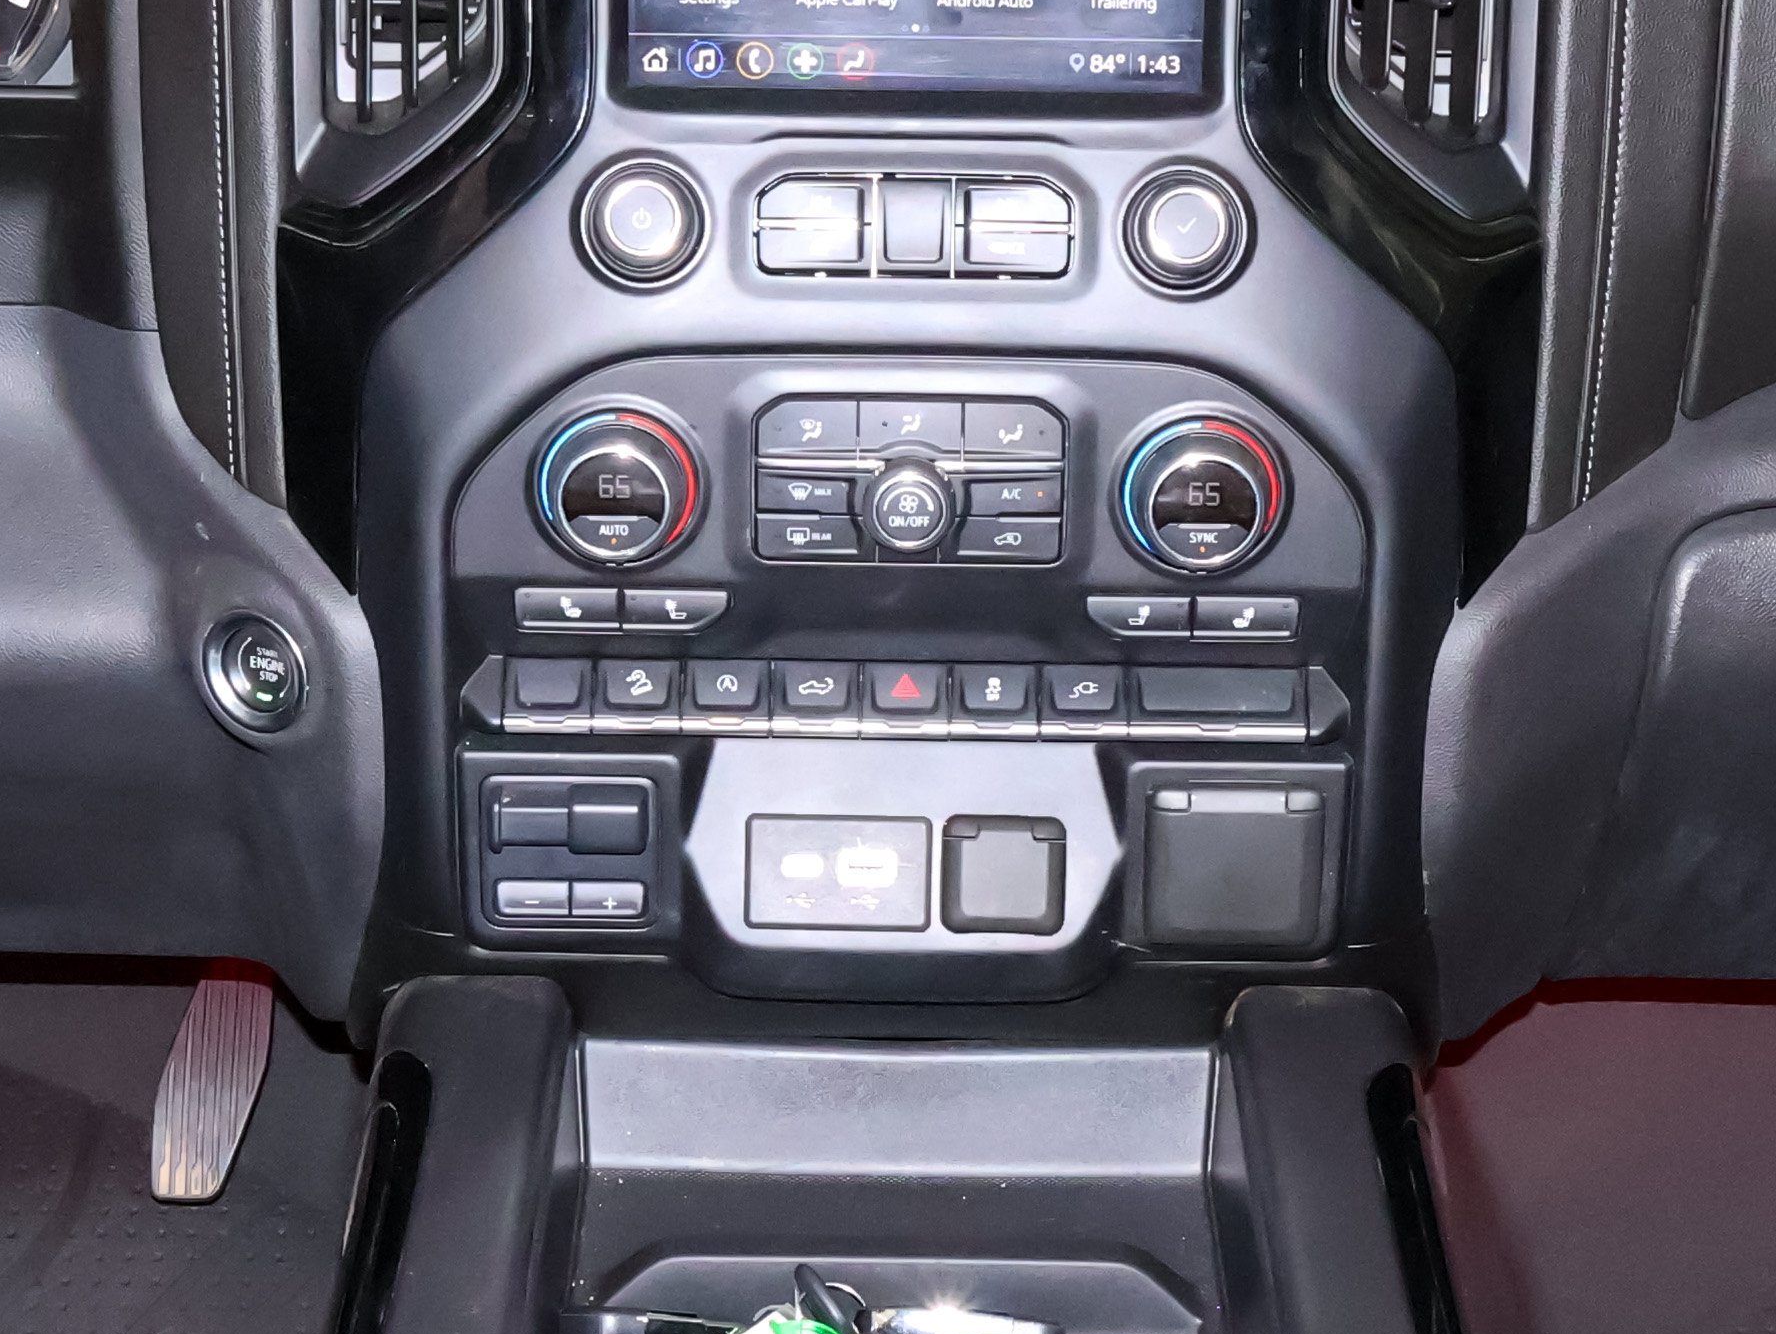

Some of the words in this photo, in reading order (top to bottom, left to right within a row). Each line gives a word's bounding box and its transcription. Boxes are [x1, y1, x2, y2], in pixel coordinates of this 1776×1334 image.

[1090, 53, 1126, 74] 84°
[1137, 54, 1181, 74] 1:43
[599, 474, 632, 499] 65
[1001, 488, 1022, 500] A/C
[1188, 482, 1220, 506] 65
[599, 524, 629, 536] AUTO
[888, 515, 930, 529] ON/OFF
[1189, 532, 1218, 543] SYNC
